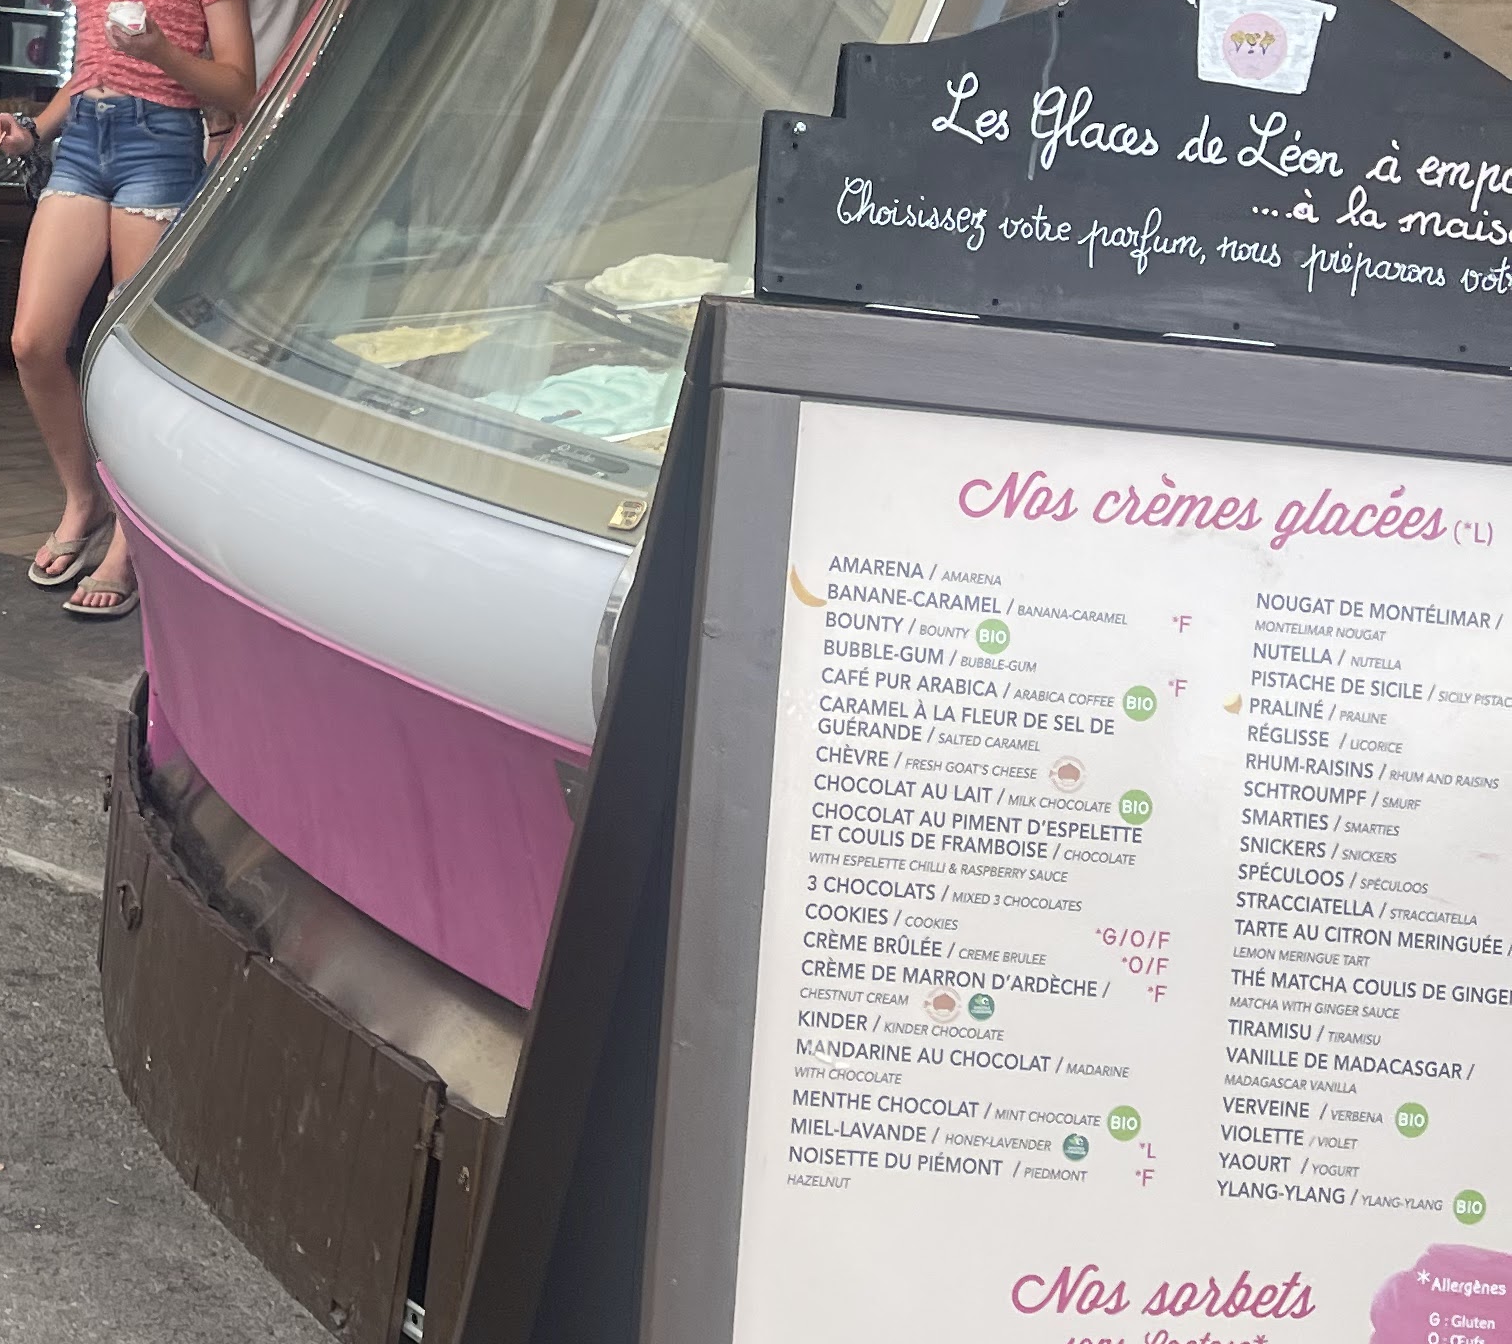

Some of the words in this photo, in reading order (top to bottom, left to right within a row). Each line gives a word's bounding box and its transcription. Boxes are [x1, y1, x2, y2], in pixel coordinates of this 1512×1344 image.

[932, 72, 1011, 145] Les
[1031, 86, 1162, 170] Glaces
[1177, 117, 1228, 167] de
[1238, 111, 1343, 177] Léon
[1366, 139, 1402, 184] à
[1336, 185, 1386, 230] la
[1398, 209, 1512, 246] mais
[836, 176, 987, 251] Choisissez
[999, 211, 1072, 244] votre
[1217, 236, 1281, 268] nous
[1300, 242, 1446, 297] préparons
[958, 470, 1079, 522] Nos
[1092, 473, 1263, 532] crèmes
[1269, 485, 1448, 550] glacées
[828, 555, 924, 579] AMARENA
[941, 570, 1002, 586] AMARENA
[827, 583, 1001, 614] BANANE-CARAMEL
[1017, 604, 1128, 625] BANANA-CARAMEL
[1256, 592, 1335, 615] NOUGAT
[1339, 599, 1364, 618] DE
[1369, 602, 1491, 629] MONTÉLIMAR
[825, 610, 904, 633] BOUNTY
[919, 624, 970, 639] BOUNTY
[978, 628, 1007, 645] BIO
[823, 638, 944, 665] BUBBLE-GUM
[960, 655, 1037, 673] BUBBLE-GUM
[1253, 641, 1333, 665] NUTELLA
[1350, 655, 1402, 670] NUTELLA
[821, 666, 869, 687] CAFÉ
[875, 671, 911, 691] PUR
[916, 675, 998, 698] ARABICA
[1012, 688, 1065, 703] ARABICA
[1068, 692, 1115, 707] COFFEE
[1125, 695, 1154, 712] BIO
[818, 715, 922, 742] GUÉRANDE
[937, 732, 982, 747] SALTED
[984, 736, 1040, 752] CARAMEL
[815, 743, 889, 767] CHÈVRE
[904, 757, 943, 771] FRESH
[945, 761, 989, 776] GOAT'S
[991, 764, 1038, 779] CHEESE
[1243, 780, 1367, 805] SCHTROUMPF
[1382, 796, 1422, 810] SMURF
[811, 801, 915, 825] CHOCOLAT
[918, 810, 946, 828] AU
[952, 812, 1023, 834] PIMENT
[1027, 818, 1143, 844] D'ESPELETTE
[809, 851, 840, 865] WITH
[842, 854, 907, 870] ESPELETTE
[908, 859, 946, 873] CHILLI
[948, 862, 957, 875] &
[960, 863, 1027, 879] RASPBERRY
[1028, 868, 1068, 883] SAUCE
[1237, 861, 1345, 888] SPÉCULOOS
[1359, 877, 1429, 894] SPÉCULOOS
[805, 902, 889, 925] COOKIES
[904, 915, 959, 931] COOKIES
[803, 928, 867, 952] CRÈME
[873, 934, 943, 958] BRÛLÉE
[958, 947, 1000, 962] CREME
[1002, 951, 1047, 965] BRULEE
[1232, 945, 1276, 960] LEMON
[1278, 949, 1340, 965] MERINGUE
[1343, 954, 1371, 967] TART
[792, 1088, 872, 1111] MENTHE
[877, 1094, 980, 1118] CHOCOLAT
[994, 1108, 1027, 1121] MINT
[1028, 1110, 1101, 1126] CHOCOLATE
[1110, 1116, 1139, 1131] BIO
[1222, 1096, 1310, 1118] VERVEINE
[1330, 1109, 1383, 1124] VERBENA
[1397, 1113, 1426, 1128] BIO
[790, 1117, 927, 1143] MIEL-LAVANDE
[944, 1133, 1052, 1151] HONEY-LAVENDER
[786, 1173, 851, 1189] HAZELNUT
[1011, 1263, 1130, 1316] Nos
[1142, 1269, 1317, 1320] sorbets
[1450, 1314, 1496, 1330] Gluten
